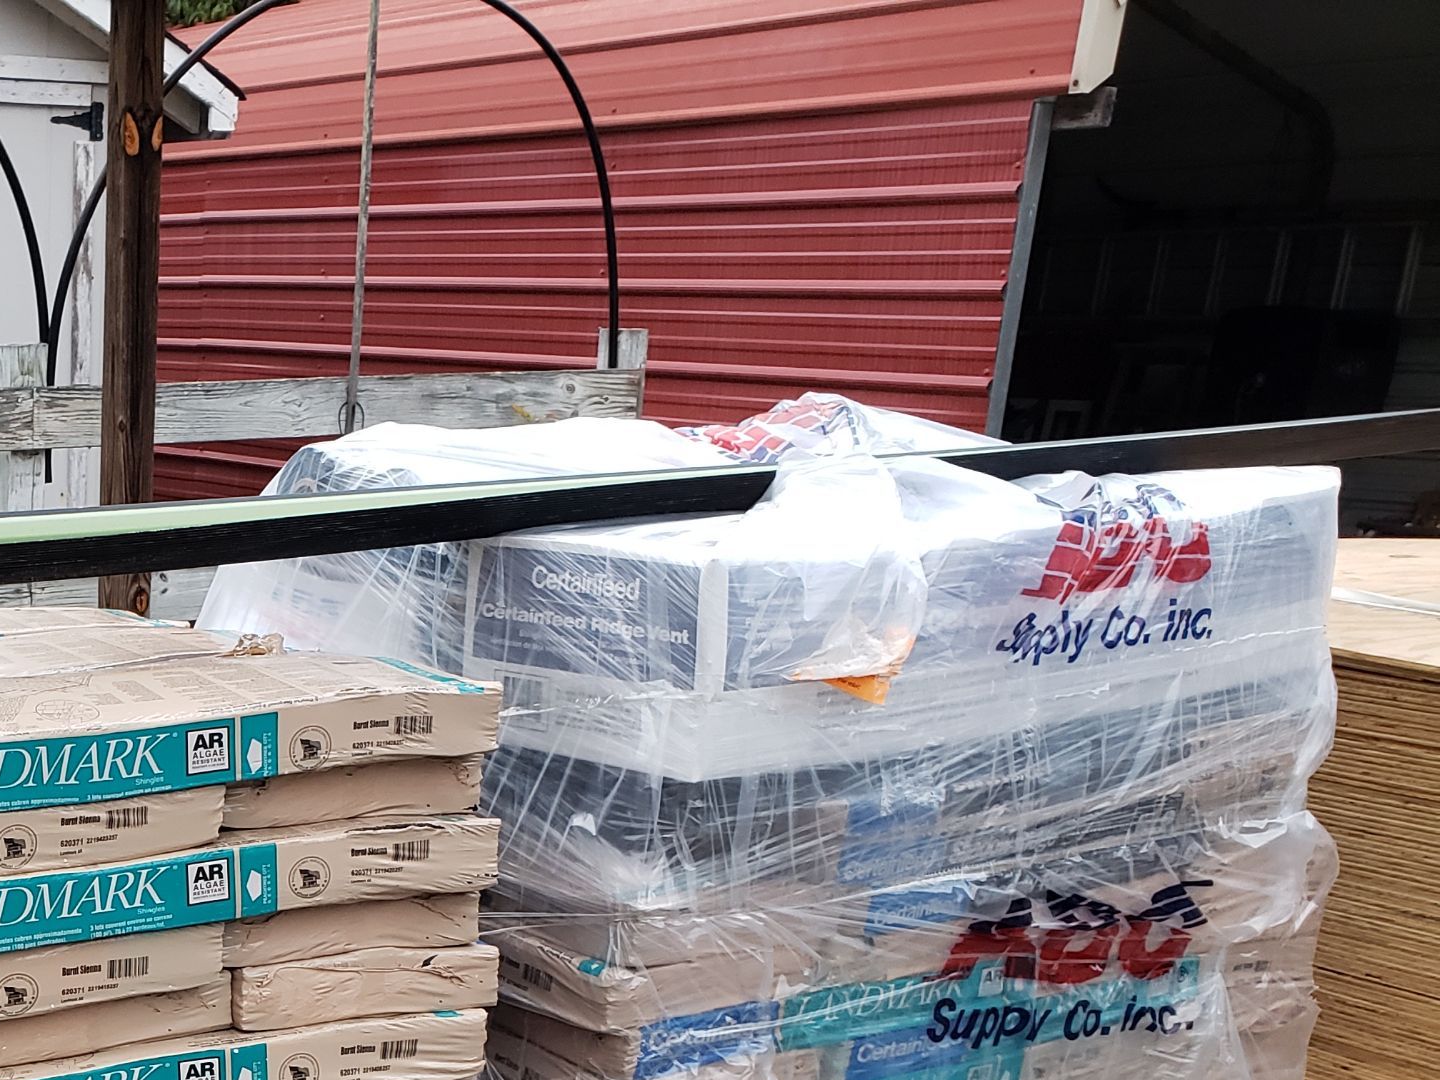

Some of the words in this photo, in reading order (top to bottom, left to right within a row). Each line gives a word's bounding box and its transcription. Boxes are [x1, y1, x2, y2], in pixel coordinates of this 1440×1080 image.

[531, 564, 641, 602] CertainTeed
[481, 600, 586, 630] CertainTeed
[591, 617, 645, 640] Ridge
[1101, 604, 1150, 649] Co.
[1162, 598, 1213, 642] inc.
[193, 732, 224, 750] AR
[192, 749, 225, 759] ALGAE
[192, 757, 226, 765] RESISTANT
[135, 776, 164, 786] Shingles
[193, 863, 223, 883] AR
[193, 880, 224, 891] ALGAE
[193, 886, 225, 896] RESISTANT
[137, 905, 166, 915] Shingles
[1064, 1000, 1110, 1041] Co.
[185, 1061, 215, 1080] AR
